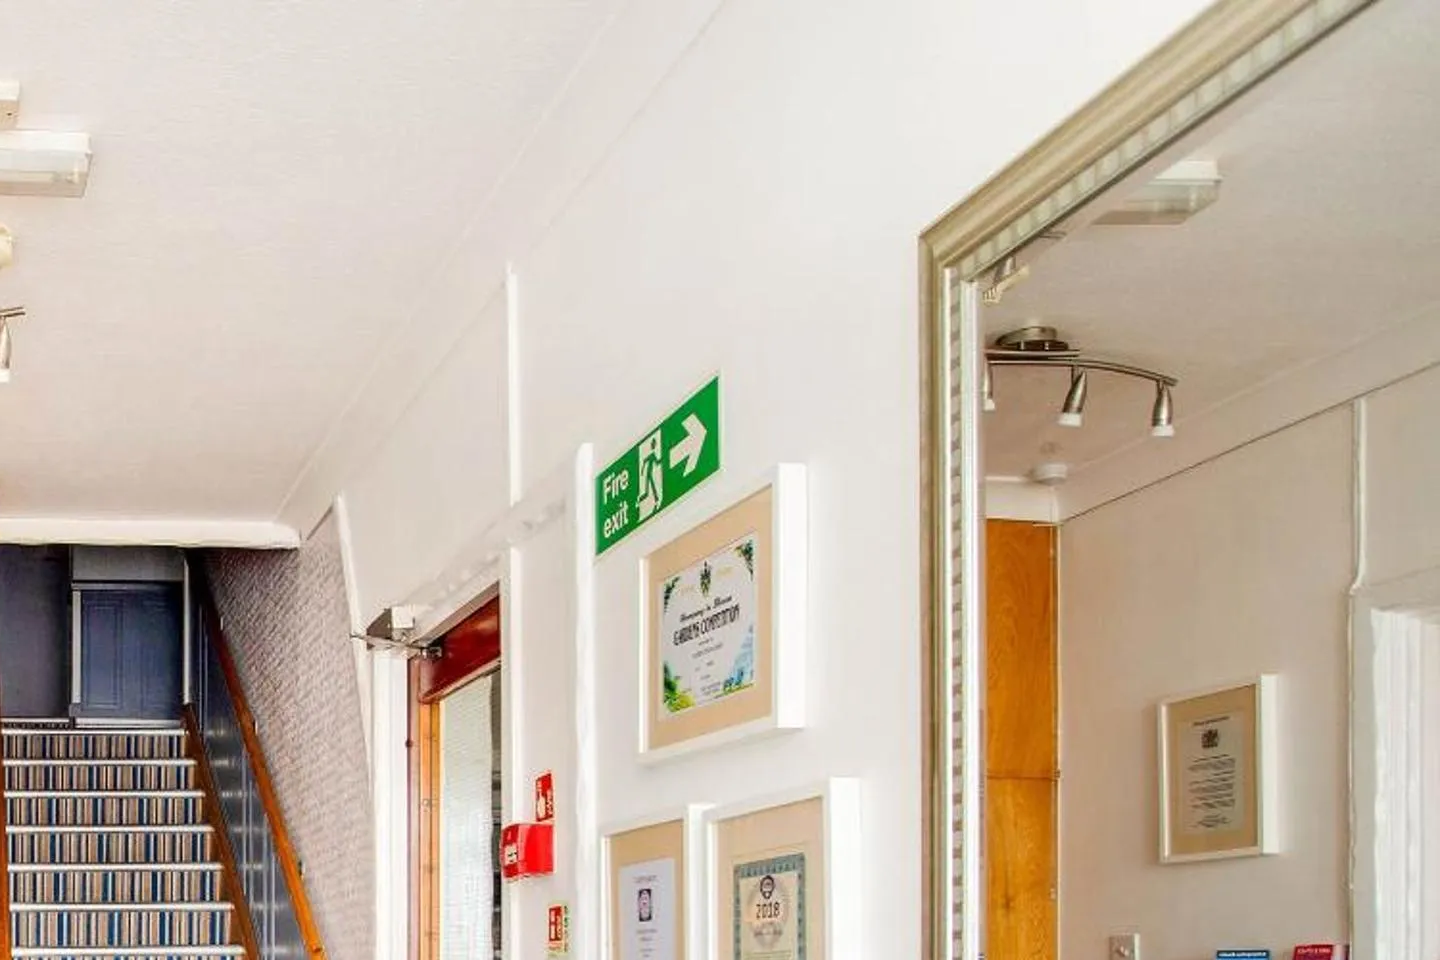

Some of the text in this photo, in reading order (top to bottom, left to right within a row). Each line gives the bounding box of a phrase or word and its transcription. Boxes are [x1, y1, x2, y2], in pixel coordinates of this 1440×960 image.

[603, 469, 629, 505] Fire
[604, 501, 629, 539] exit
[755, 901, 781, 919] 2018
